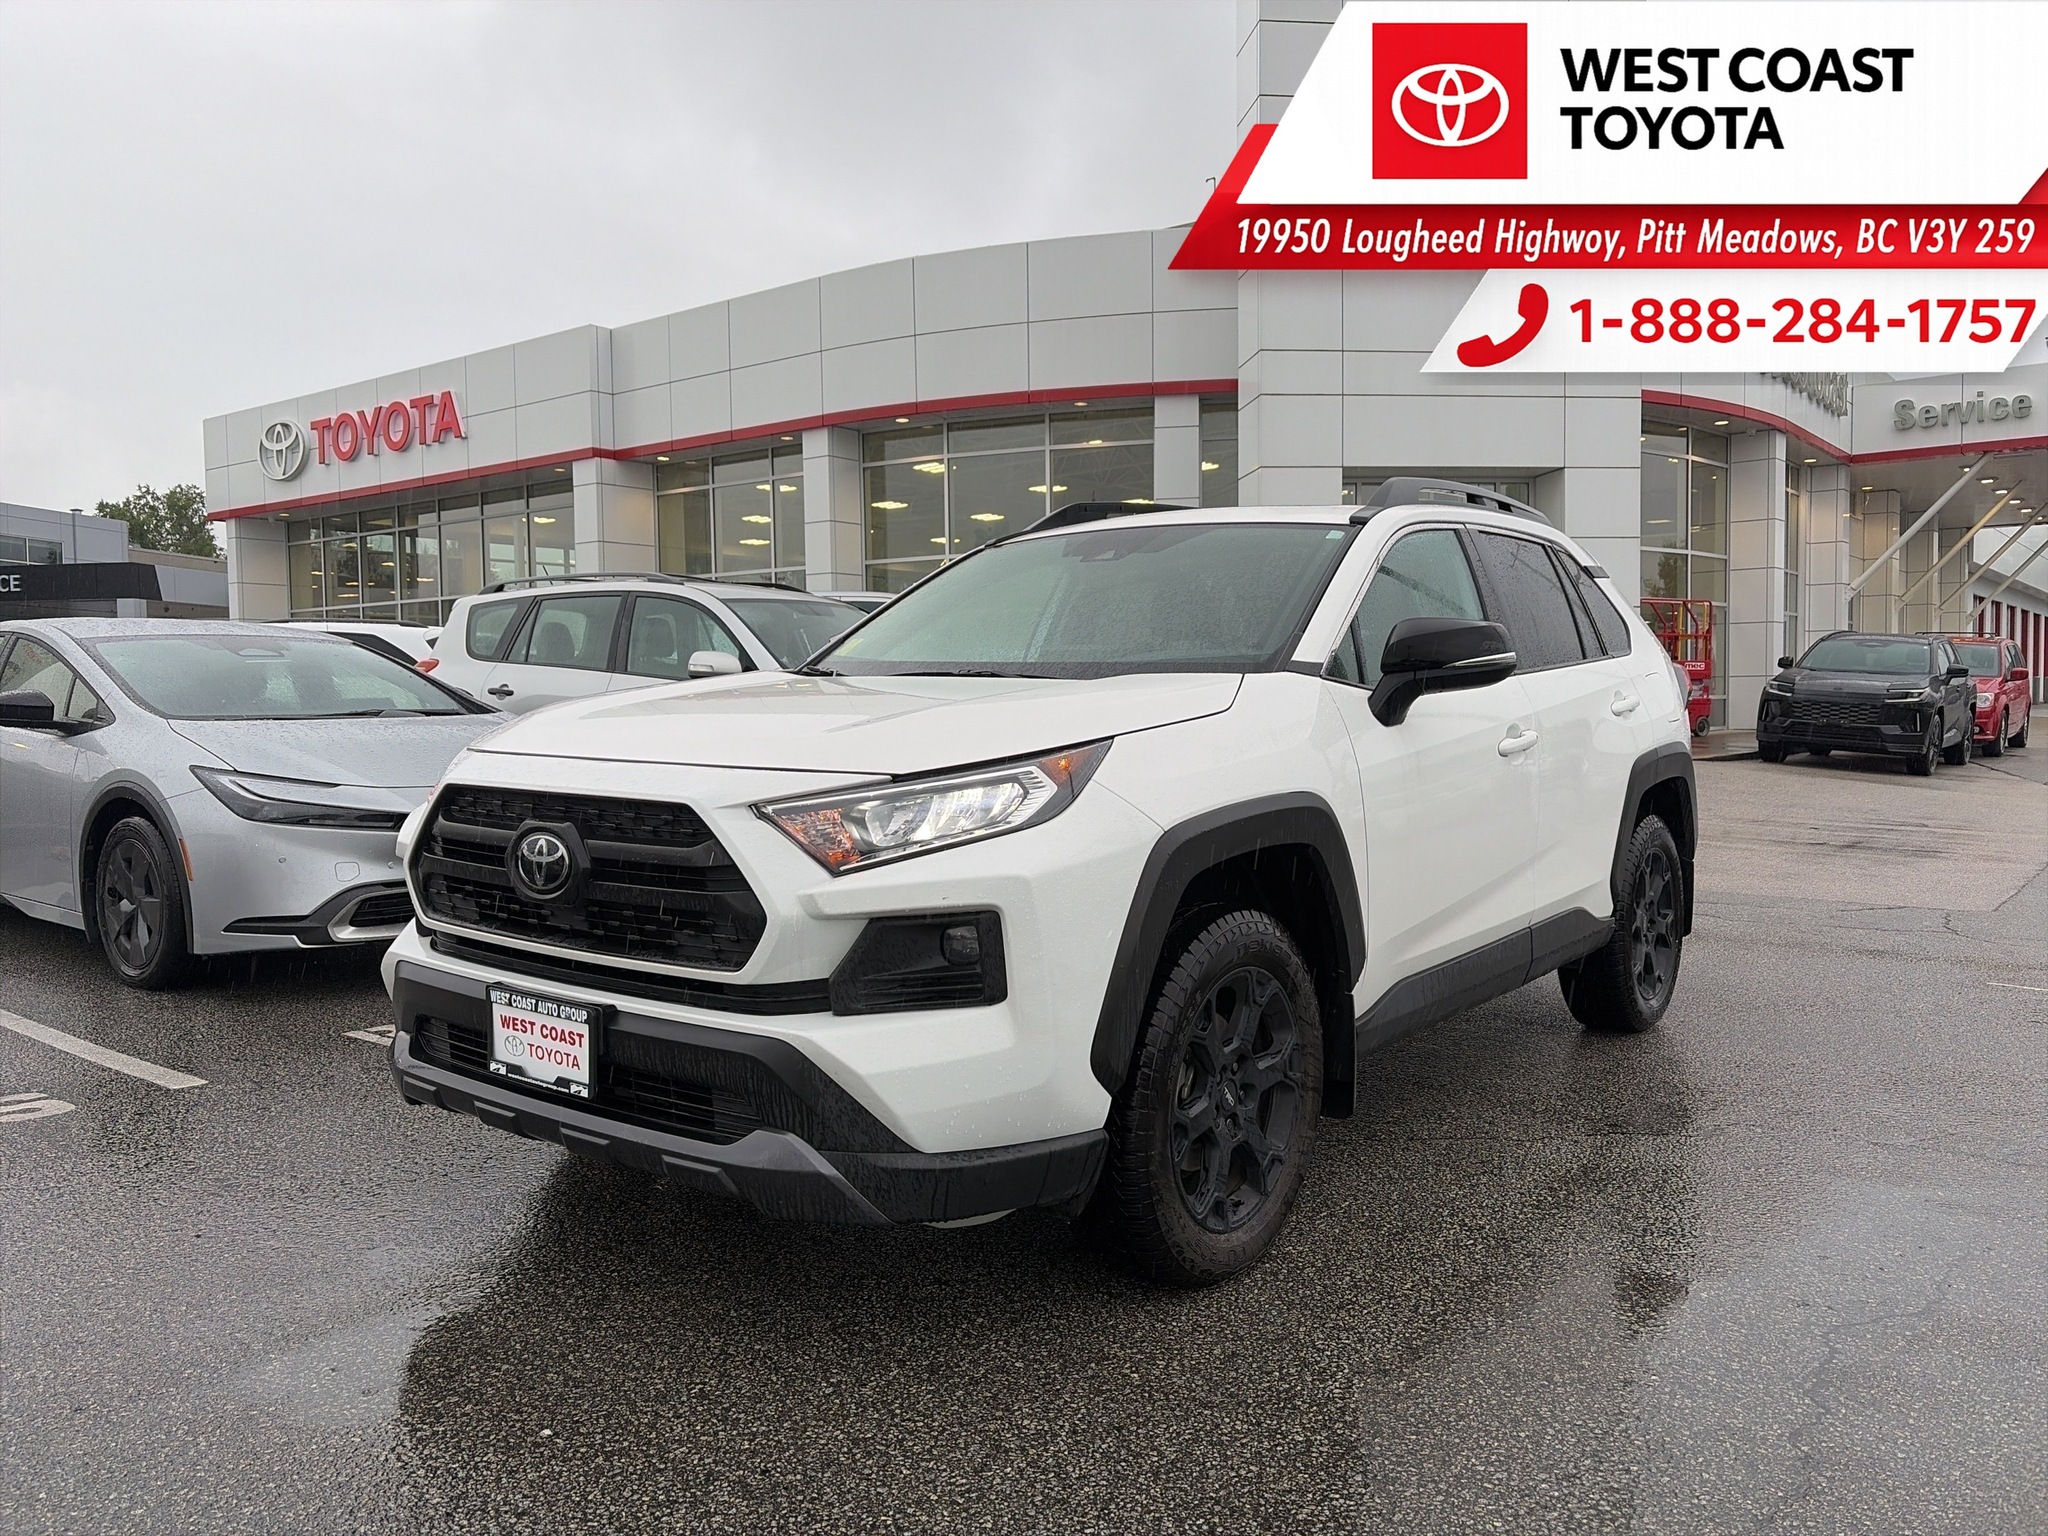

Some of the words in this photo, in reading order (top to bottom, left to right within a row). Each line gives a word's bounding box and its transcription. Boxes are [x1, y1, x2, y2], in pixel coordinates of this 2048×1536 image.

[1893, 389, 2033, 431] Service
[310, 390, 466, 465] TOYOTA
[490, 989, 510, 1005] WEST
[511, 994, 536, 1012] COAST
[537, 1001, 558, 1017] AUTO
[560, 1005, 588, 1023] GROUP
[500, 1014, 536, 1036] WEST
[540, 1023, 585, 1048] COAST
[527, 1042, 581, 1071] TOYOTA
[1223, 1086, 1235, 1107] TRD
